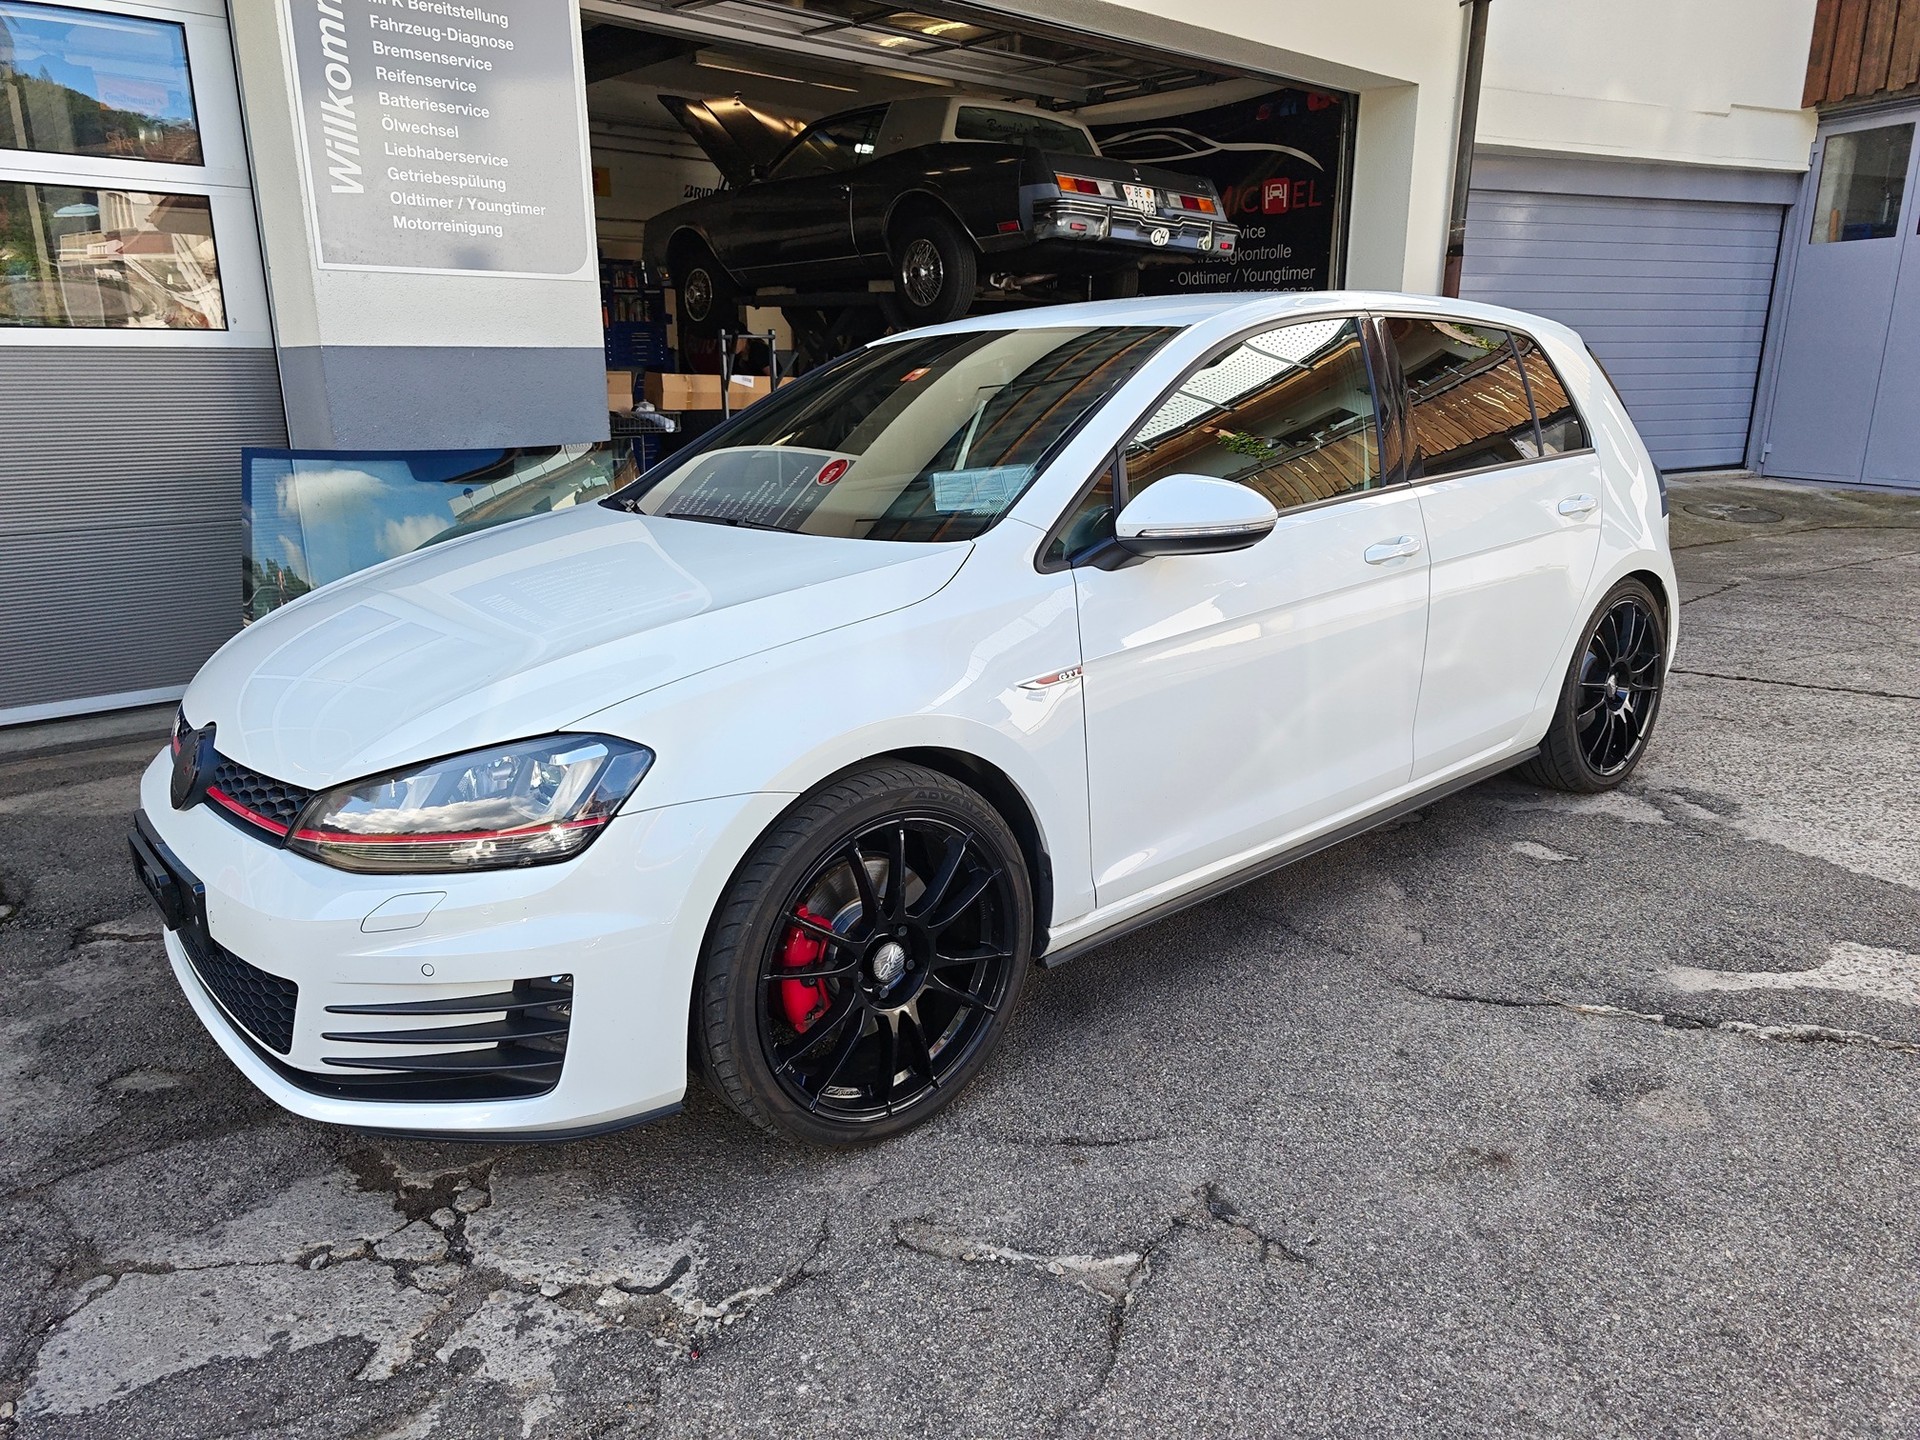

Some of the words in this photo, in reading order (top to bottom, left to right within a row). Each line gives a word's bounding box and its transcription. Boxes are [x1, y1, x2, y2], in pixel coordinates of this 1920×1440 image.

[408, 0, 509, 28] Bereitstellung
[369, 14, 515, 51] Fahrzeug-Diagnose
[372, 40, 493, 71] Bremsenservice
[375, 66, 477, 93] Reifenservice
[378, 91, 490, 118] Batterieservice
[381, 114, 459, 138] Ölwechsel
[384, 142, 509, 167] Liebhaberservice
[387, 167, 506, 192] Getriebespülung
[390, 191, 454, 210] Oldtimer
[457, 196, 464, 210] /
[467, 198, 546, 216] Youngtimer
[393, 215, 503, 238] Motorreinigung
[1153, 229, 1168, 245] CH
[1239, 225, 1266, 239] vice
[1177, 269, 1231, 286] Oldtimer
[1242, 266, 1316, 285] Youngtimer
[914, 789, 974, 812] ADVAN
